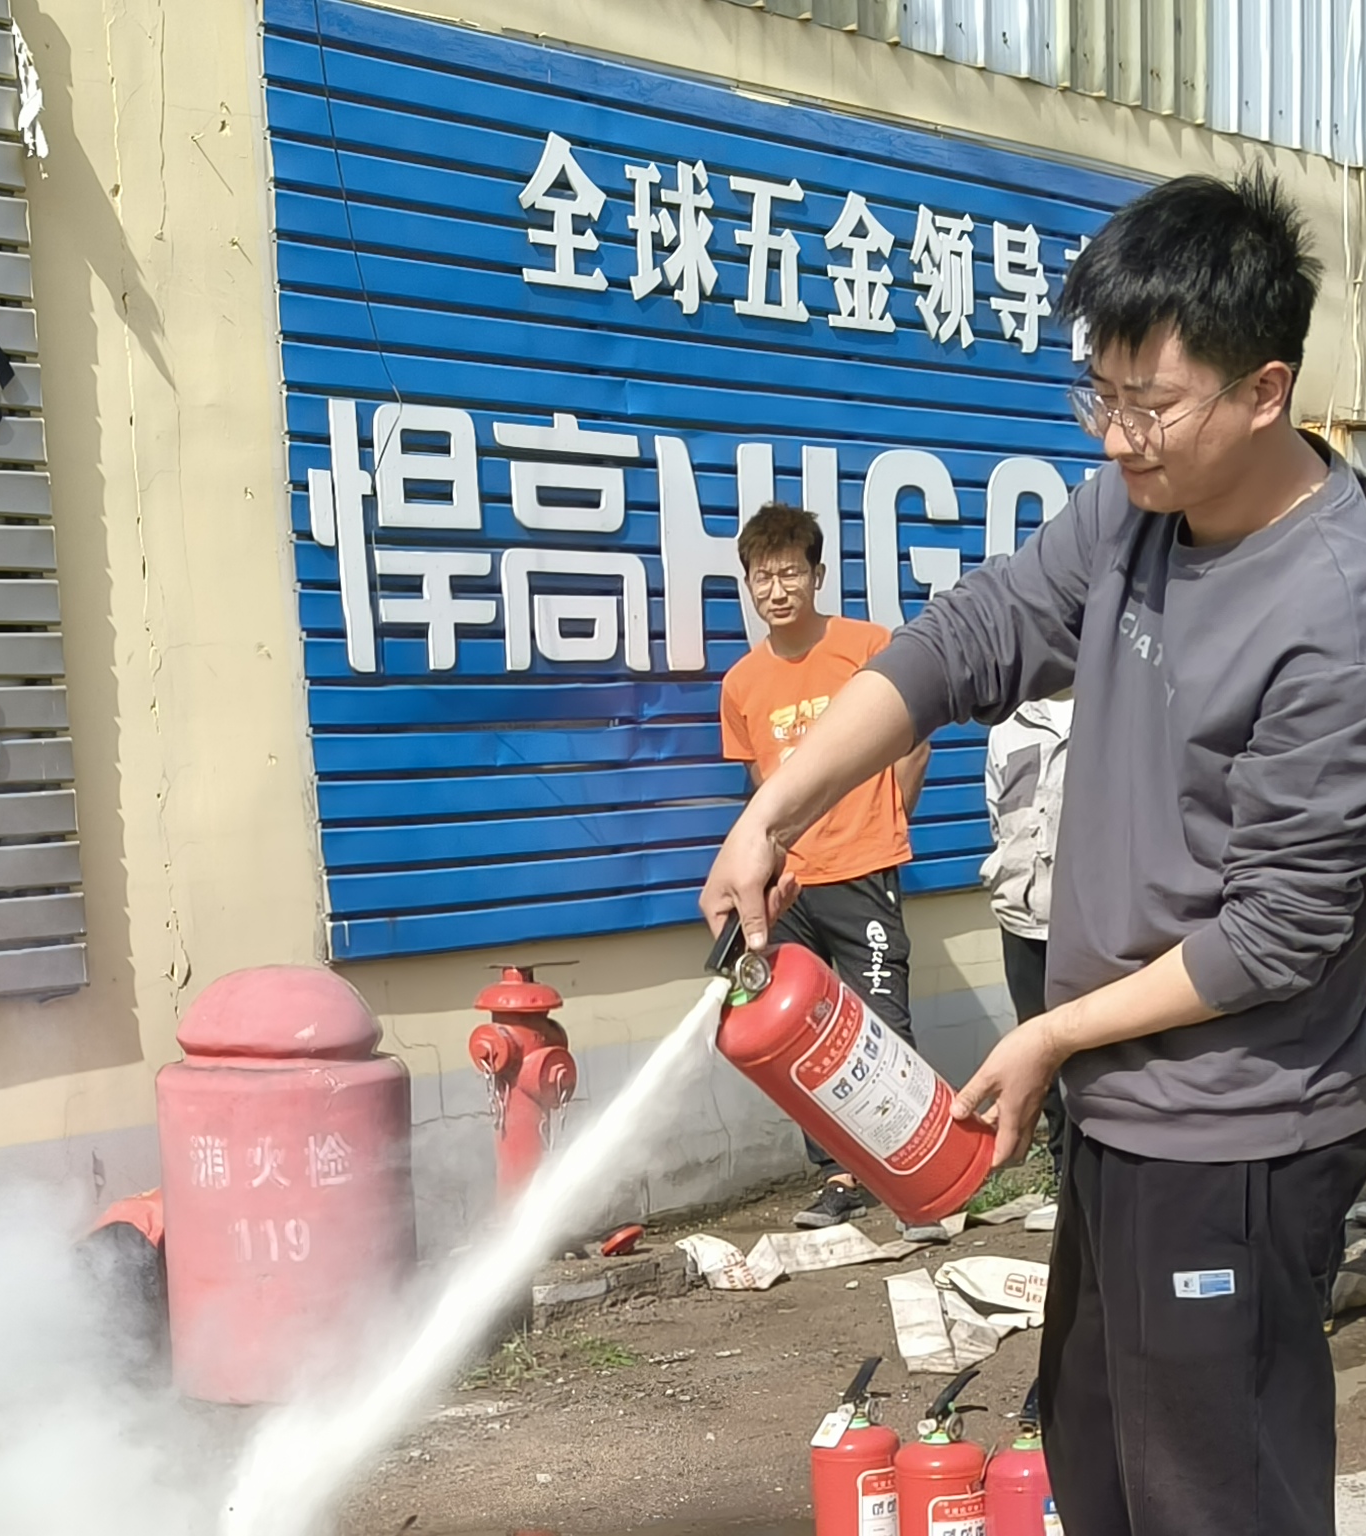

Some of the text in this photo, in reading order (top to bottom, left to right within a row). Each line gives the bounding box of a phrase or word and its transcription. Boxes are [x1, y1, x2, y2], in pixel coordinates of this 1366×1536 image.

[520, 131, 1092, 361] 全球五金领导
[228, 1217, 310, 1263] 119
